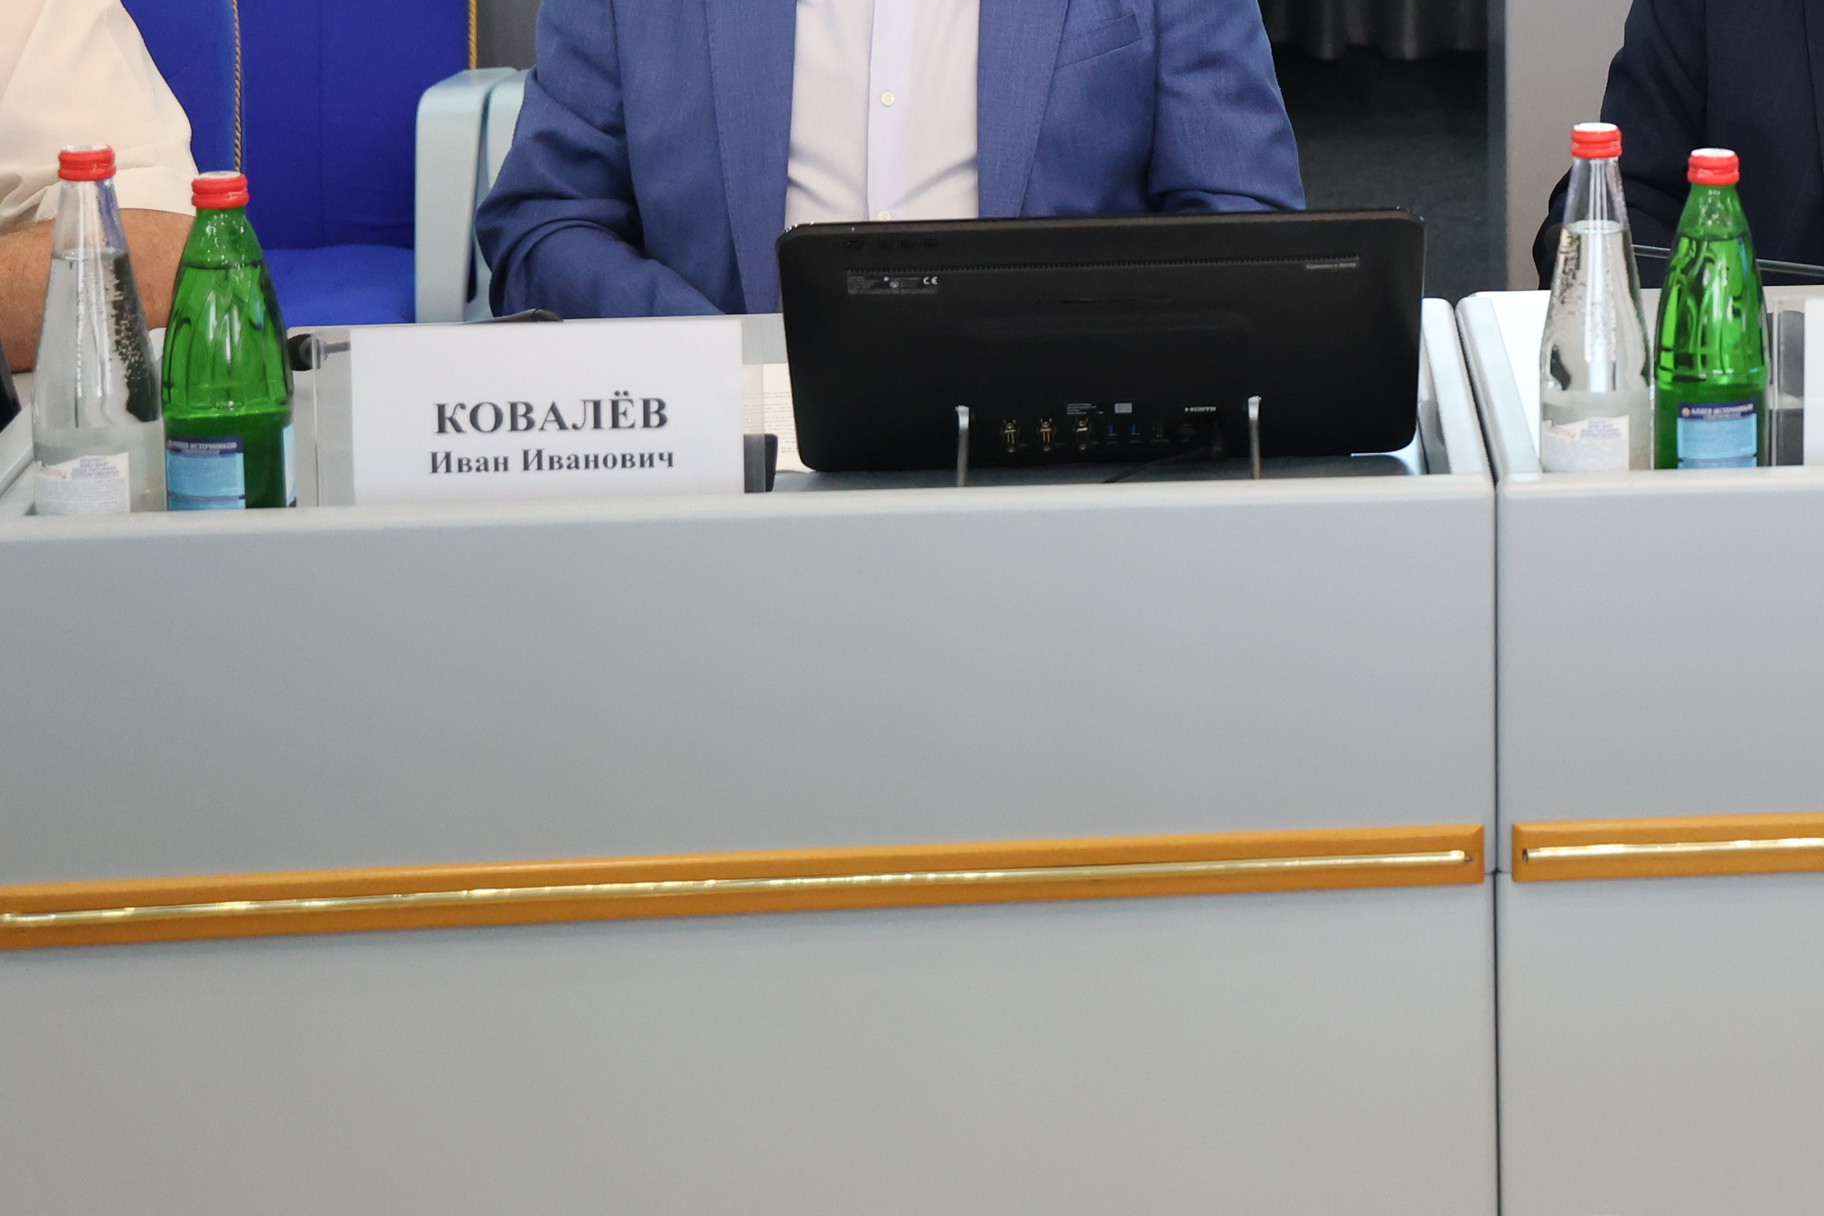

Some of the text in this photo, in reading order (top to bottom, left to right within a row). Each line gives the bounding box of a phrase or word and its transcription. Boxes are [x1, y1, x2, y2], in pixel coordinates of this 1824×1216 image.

[435, 389, 669, 436] КОВАЛЁВ
[430, 448, 675, 475] Иван Иванович
